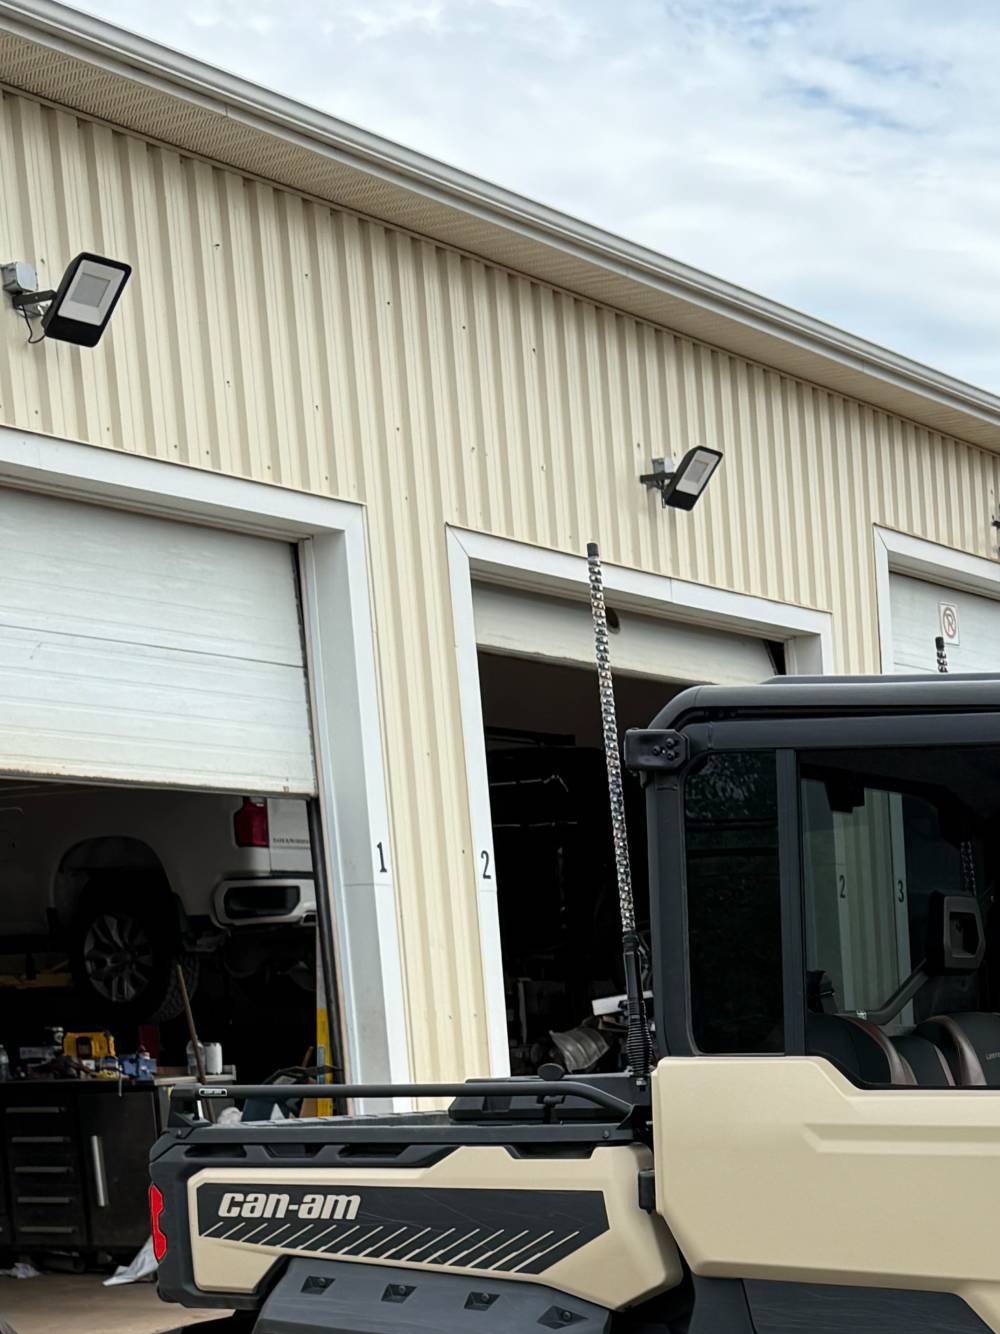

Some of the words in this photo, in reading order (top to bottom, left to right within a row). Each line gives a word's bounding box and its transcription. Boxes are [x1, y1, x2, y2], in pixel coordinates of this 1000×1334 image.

[376, 841, 388, 873] 1
[480, 850, 492, 880] 2
[839, 874, 847, 899] 2
[896, 879, 905, 903] 3
[217, 1192, 361, 1220] can-am
